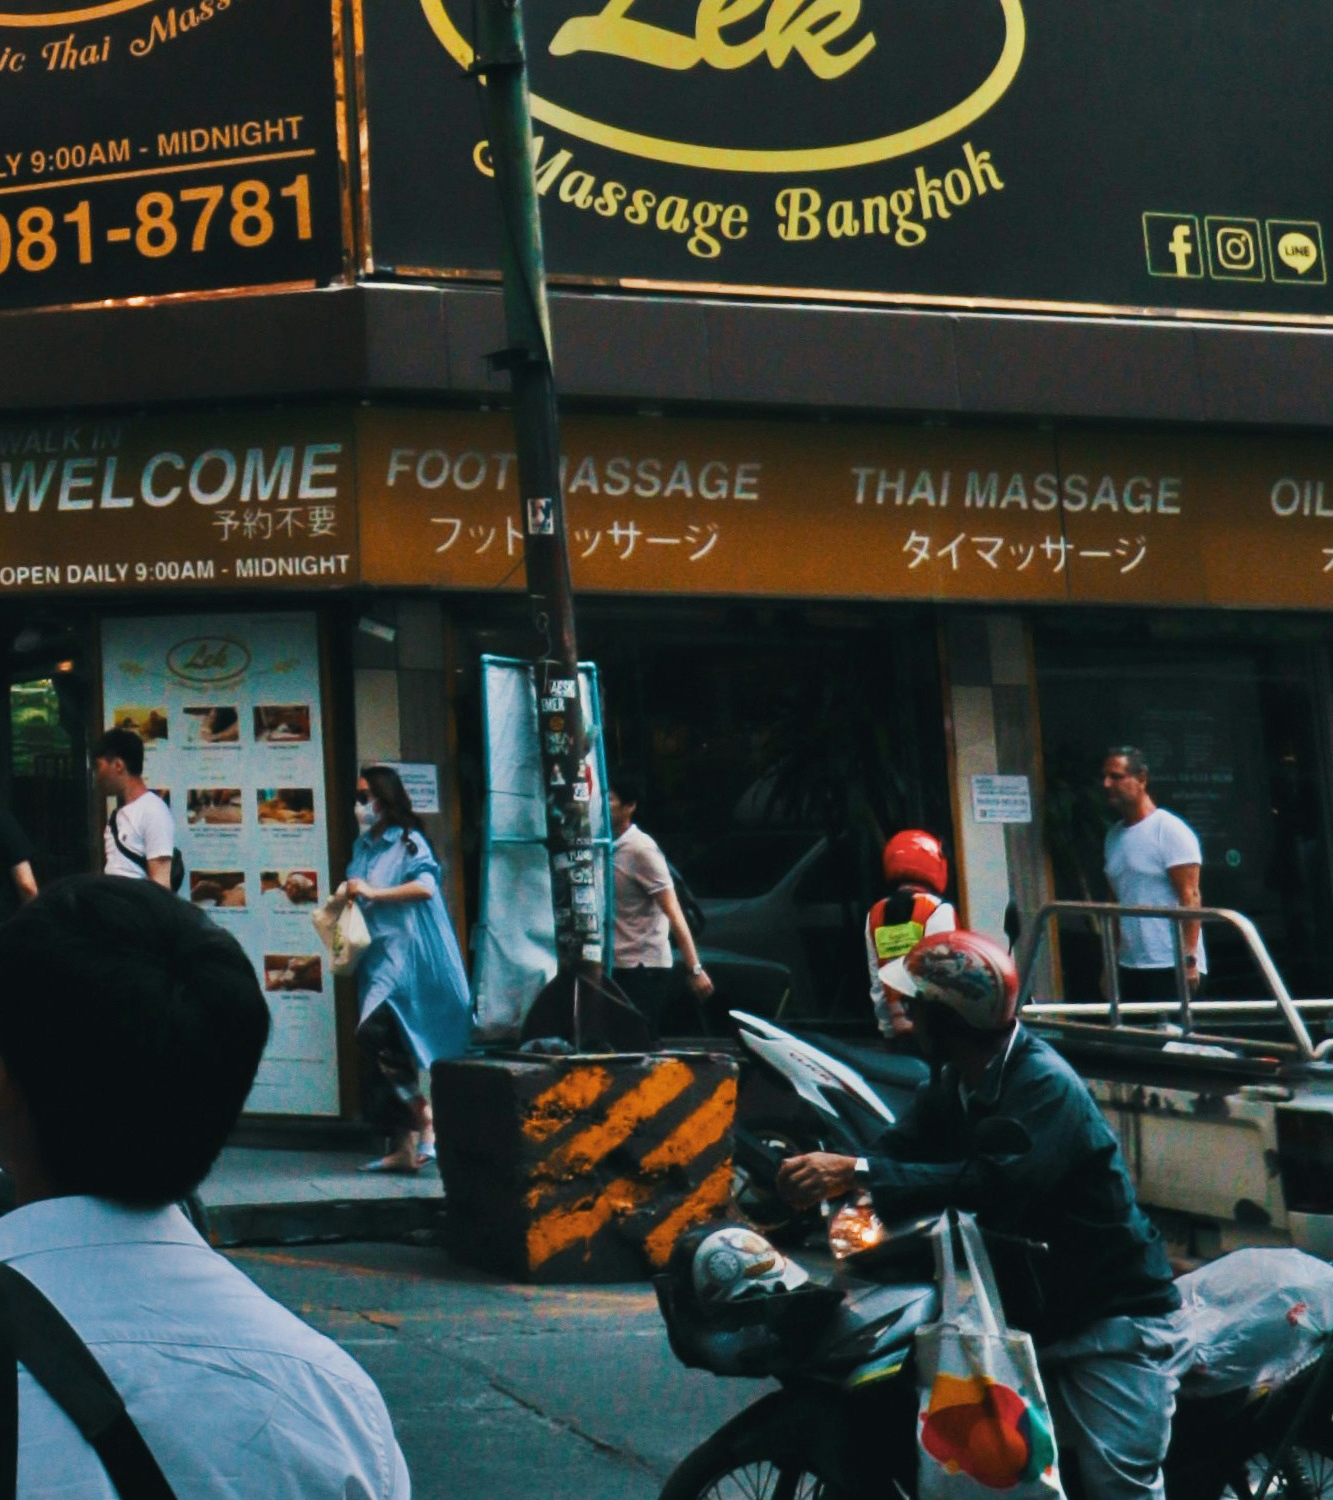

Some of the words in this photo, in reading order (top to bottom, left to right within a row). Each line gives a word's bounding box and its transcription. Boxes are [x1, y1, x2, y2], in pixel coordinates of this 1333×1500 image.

[40, 31, 112, 72] Thai
[29, 136, 132, 174] 9:00AM
[157, 115, 305, 158] MIDNIGHT
[775, 140, 1005, 247] Bangkok
[1284, 245, 1311, 258] LINE
[0, 443, 342, 513] WELCOME
[386, 447, 518, 491] FOOT
[850, 466, 951, 508] THAI
[963, 470, 1183, 516] MASSAGE
[1271, 478, 1333, 517] OIL
[211, 505, 338, 543] 予約不要
[430, 516, 721, 562] フットッサージ
[66, 563, 129, 584] DAILY
[135, 559, 215, 582] 9:00AM
[235, 554, 350, 579] MIDNIGHT
[901, 529, 1150, 574] タイマッサージ
